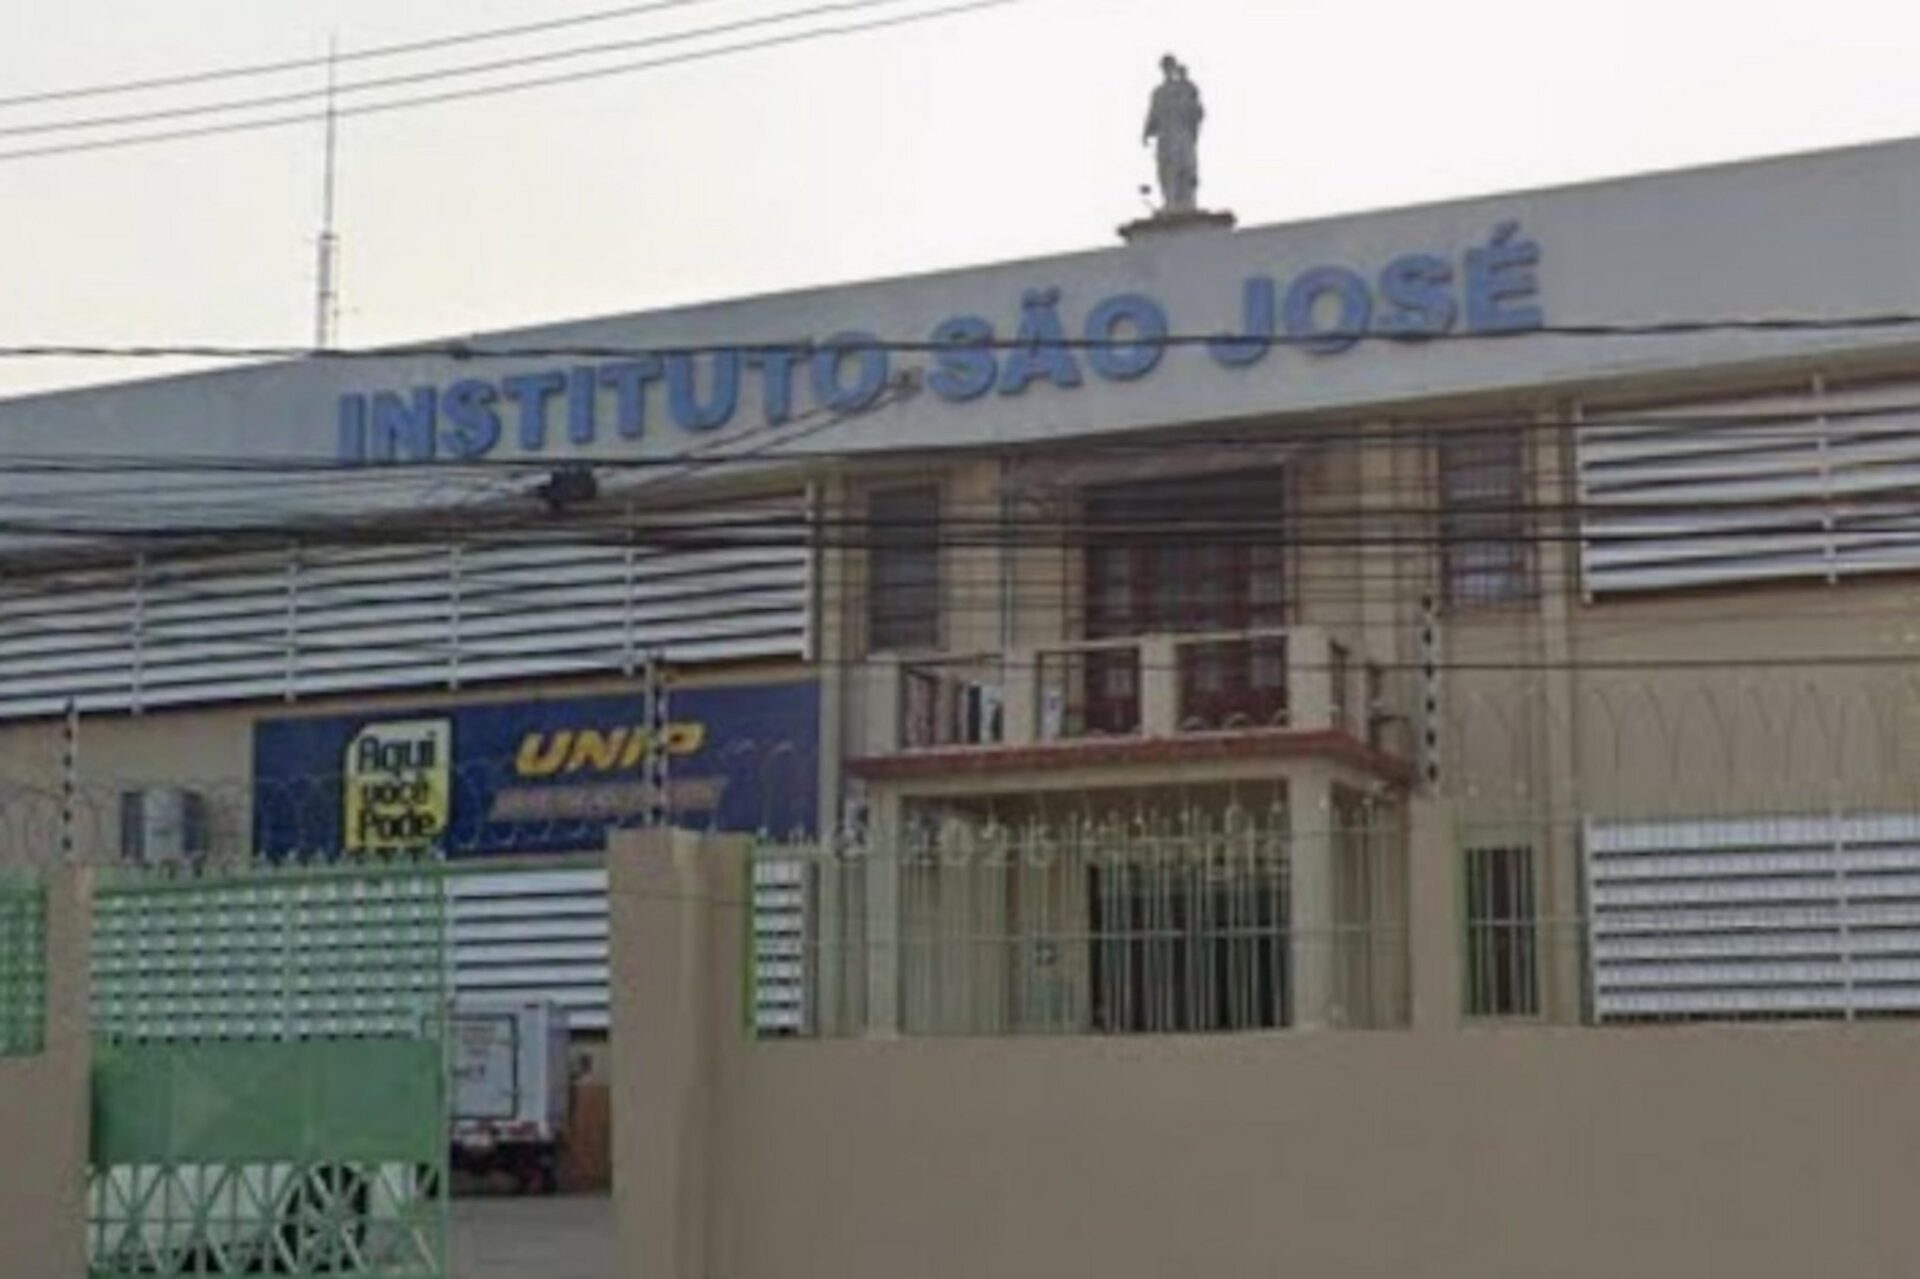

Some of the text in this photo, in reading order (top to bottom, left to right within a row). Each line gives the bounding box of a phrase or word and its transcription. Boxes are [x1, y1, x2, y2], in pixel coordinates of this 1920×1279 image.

[337, 219, 1543, 462] INSTITUTO SÃO JOSÉ
[358, 730, 438, 777] Aqui
[514, 720, 707, 776] UNIP
[357, 808, 438, 841] Pode
